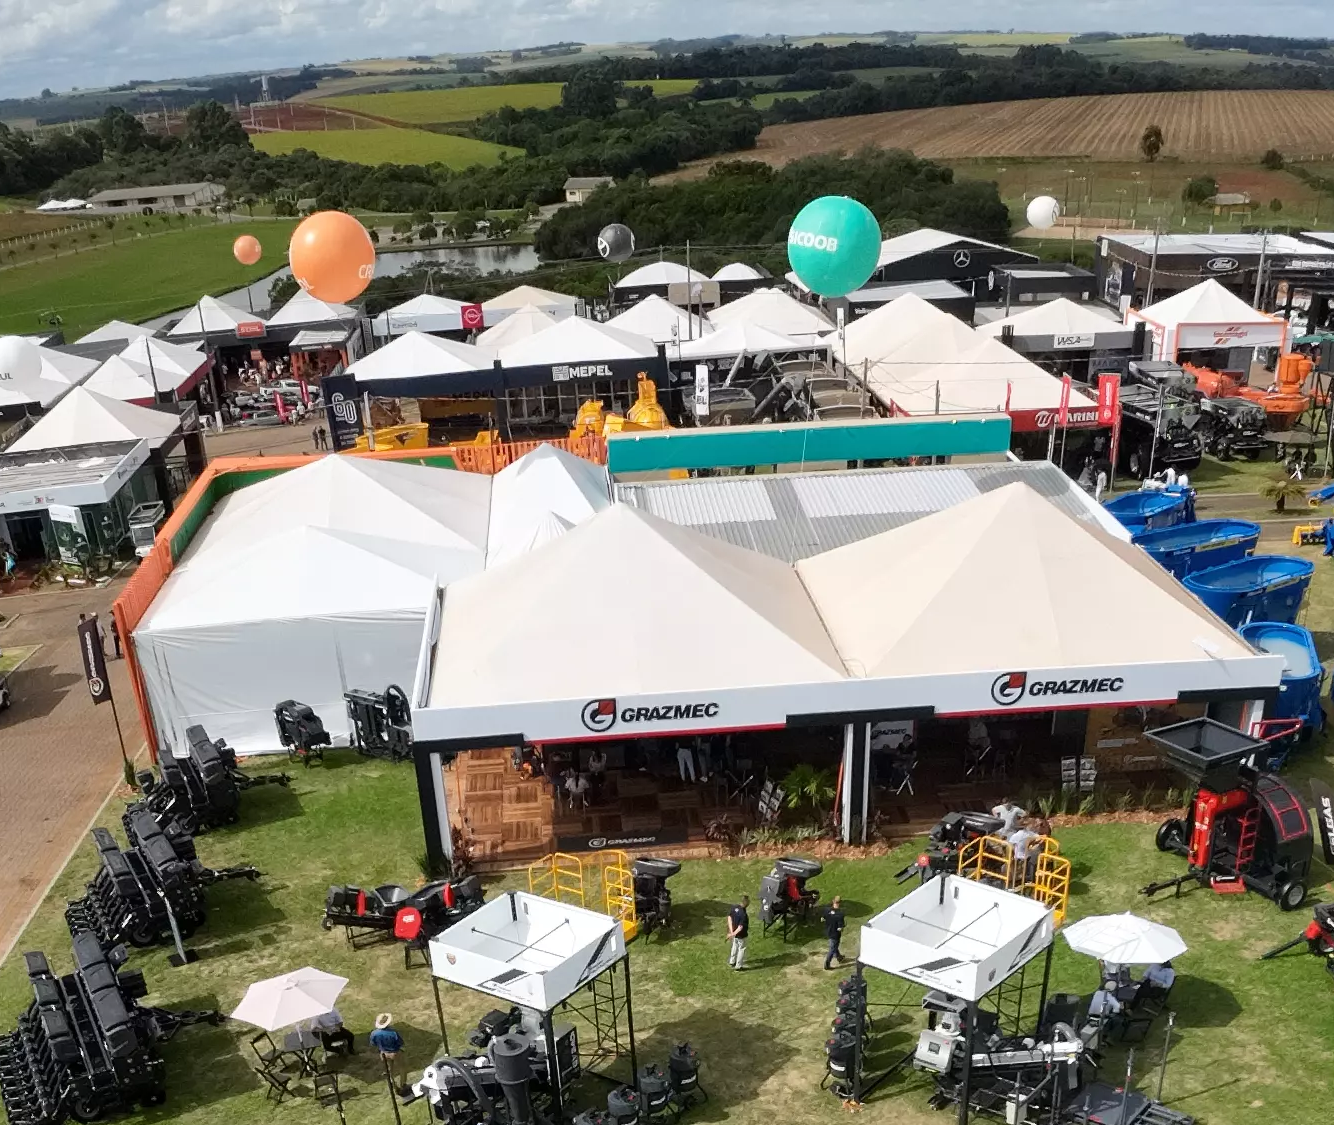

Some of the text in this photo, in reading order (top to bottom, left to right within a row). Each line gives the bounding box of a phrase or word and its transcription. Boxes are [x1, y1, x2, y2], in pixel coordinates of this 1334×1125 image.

[569, 364, 614, 379] MEPEL
[1028, 676, 1125, 697] GRAZMEC
[620, 702, 720, 723] GRAZMEC
